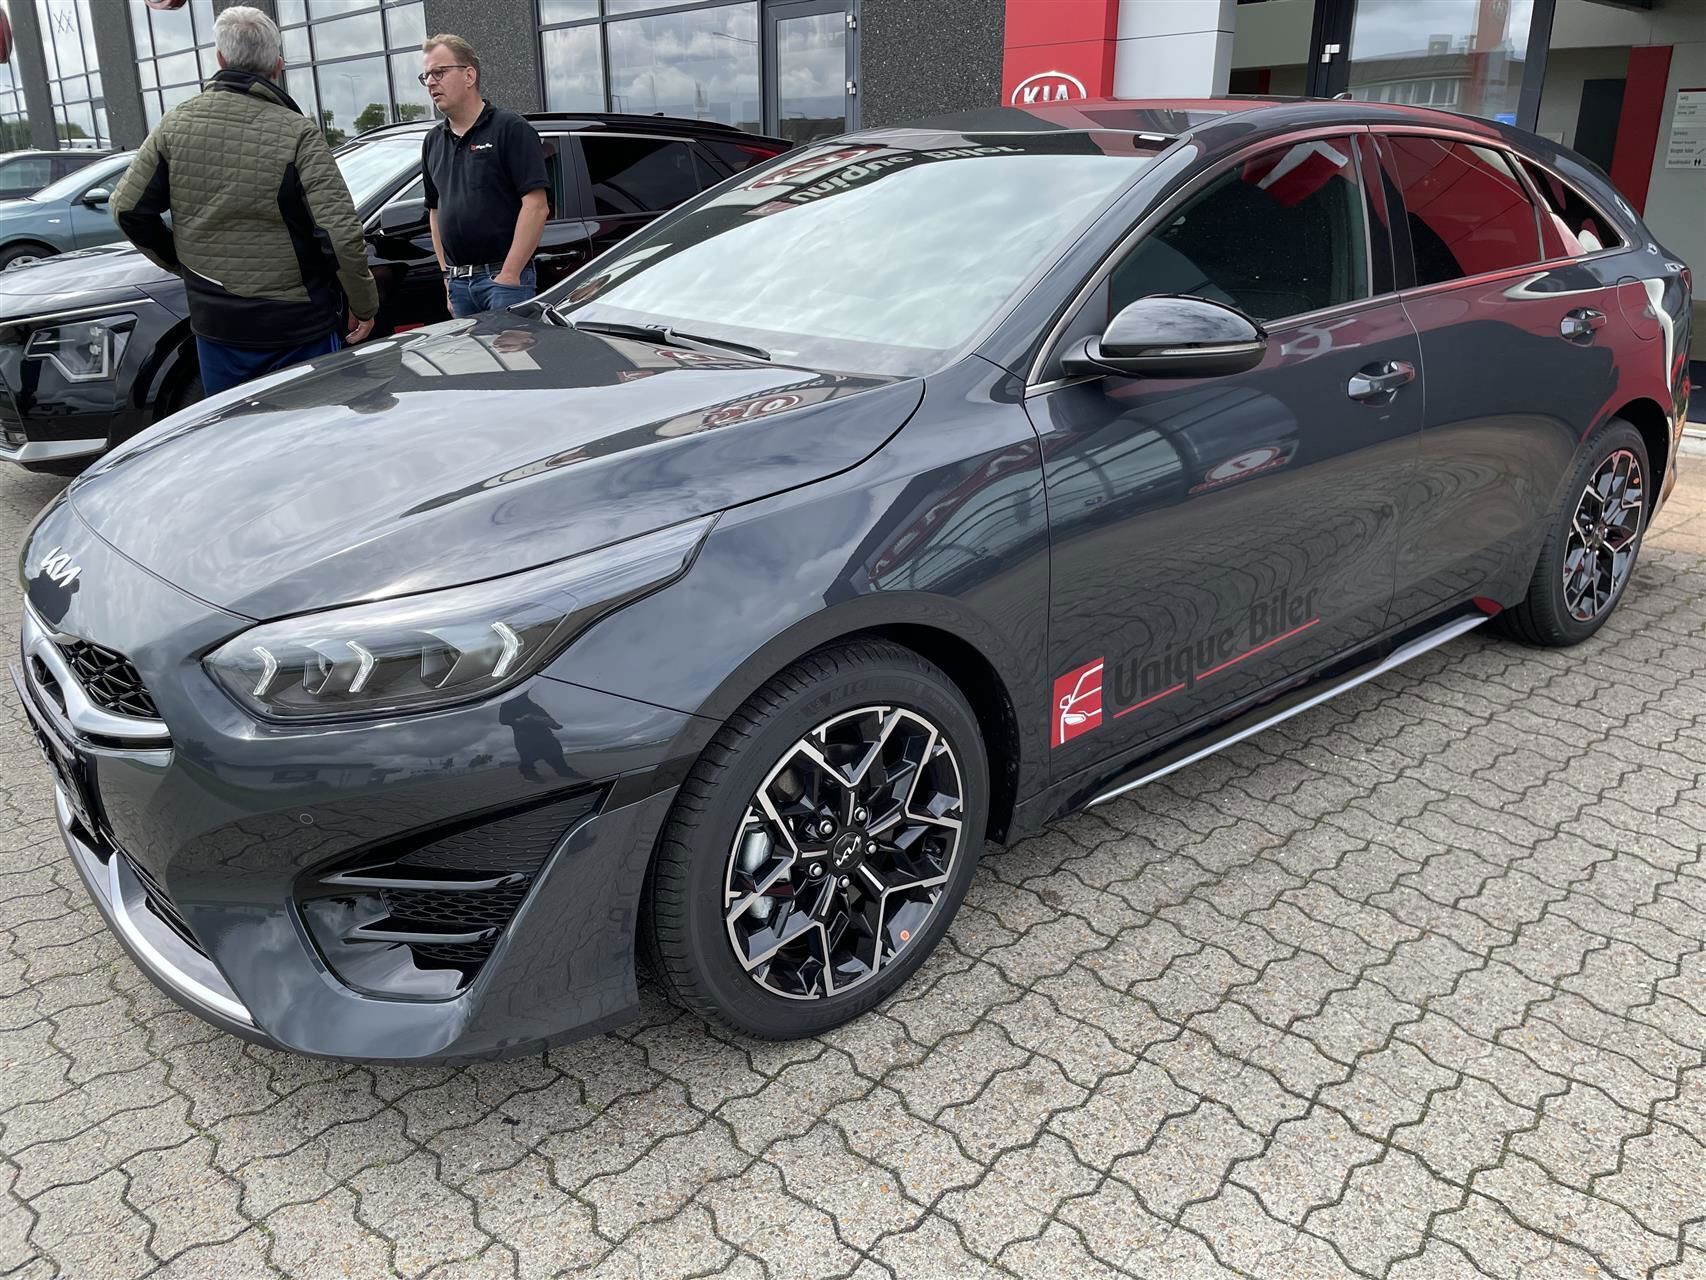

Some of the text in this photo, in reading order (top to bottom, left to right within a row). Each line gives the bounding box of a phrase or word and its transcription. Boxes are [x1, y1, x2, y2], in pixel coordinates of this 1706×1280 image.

[1023, 84, 1069, 105] KIA
[1113, 587, 1319, 707] Unique Biler
